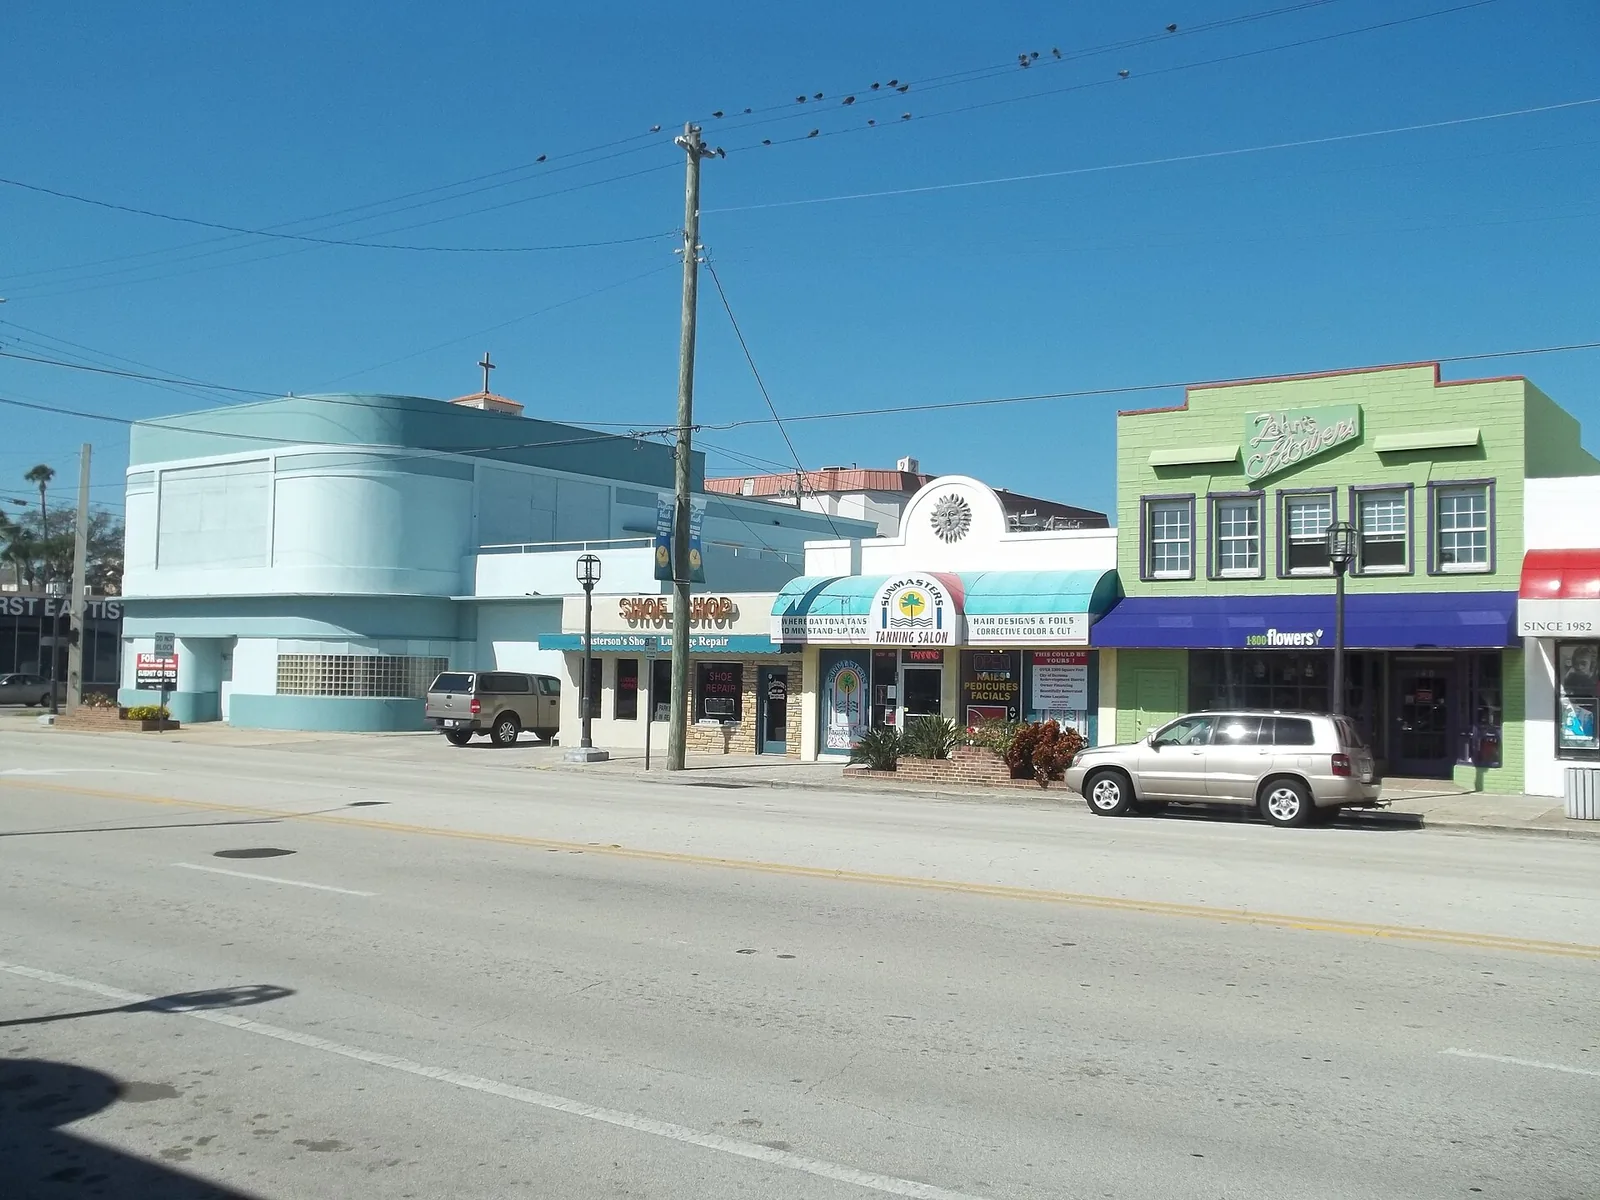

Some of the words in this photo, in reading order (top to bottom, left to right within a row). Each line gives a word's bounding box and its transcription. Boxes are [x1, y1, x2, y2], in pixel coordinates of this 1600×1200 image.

[1246, 417, 1356, 479] Flowers
[881, 578, 944, 606] SUNMASTERS
[0, 597, 38, 616] RST
[619, 598, 668, 620] SHOE
[1524, 622, 1563, 631] SINCE
[1566, 622, 1592, 631] 1982
[976, 628, 1020, 636] CORRECTIVE
[628, 636, 646, 646] Sho
[660, 636, 697, 648] Luge
[698, 636, 728, 648] Repair
[876, 631, 915, 644] TANNING
[918, 632, 948, 644] SALON
[141, 654, 155, 663] FOR
[910, 651, 940, 660] TANNING
[709, 672, 732, 681] SHOE
[976, 672, 1006, 681] NAILS
[706, 684, 736, 692] REPAIR
[964, 682, 1018, 691] PEDICURES
[971, 692, 1011, 700] FACIALS
